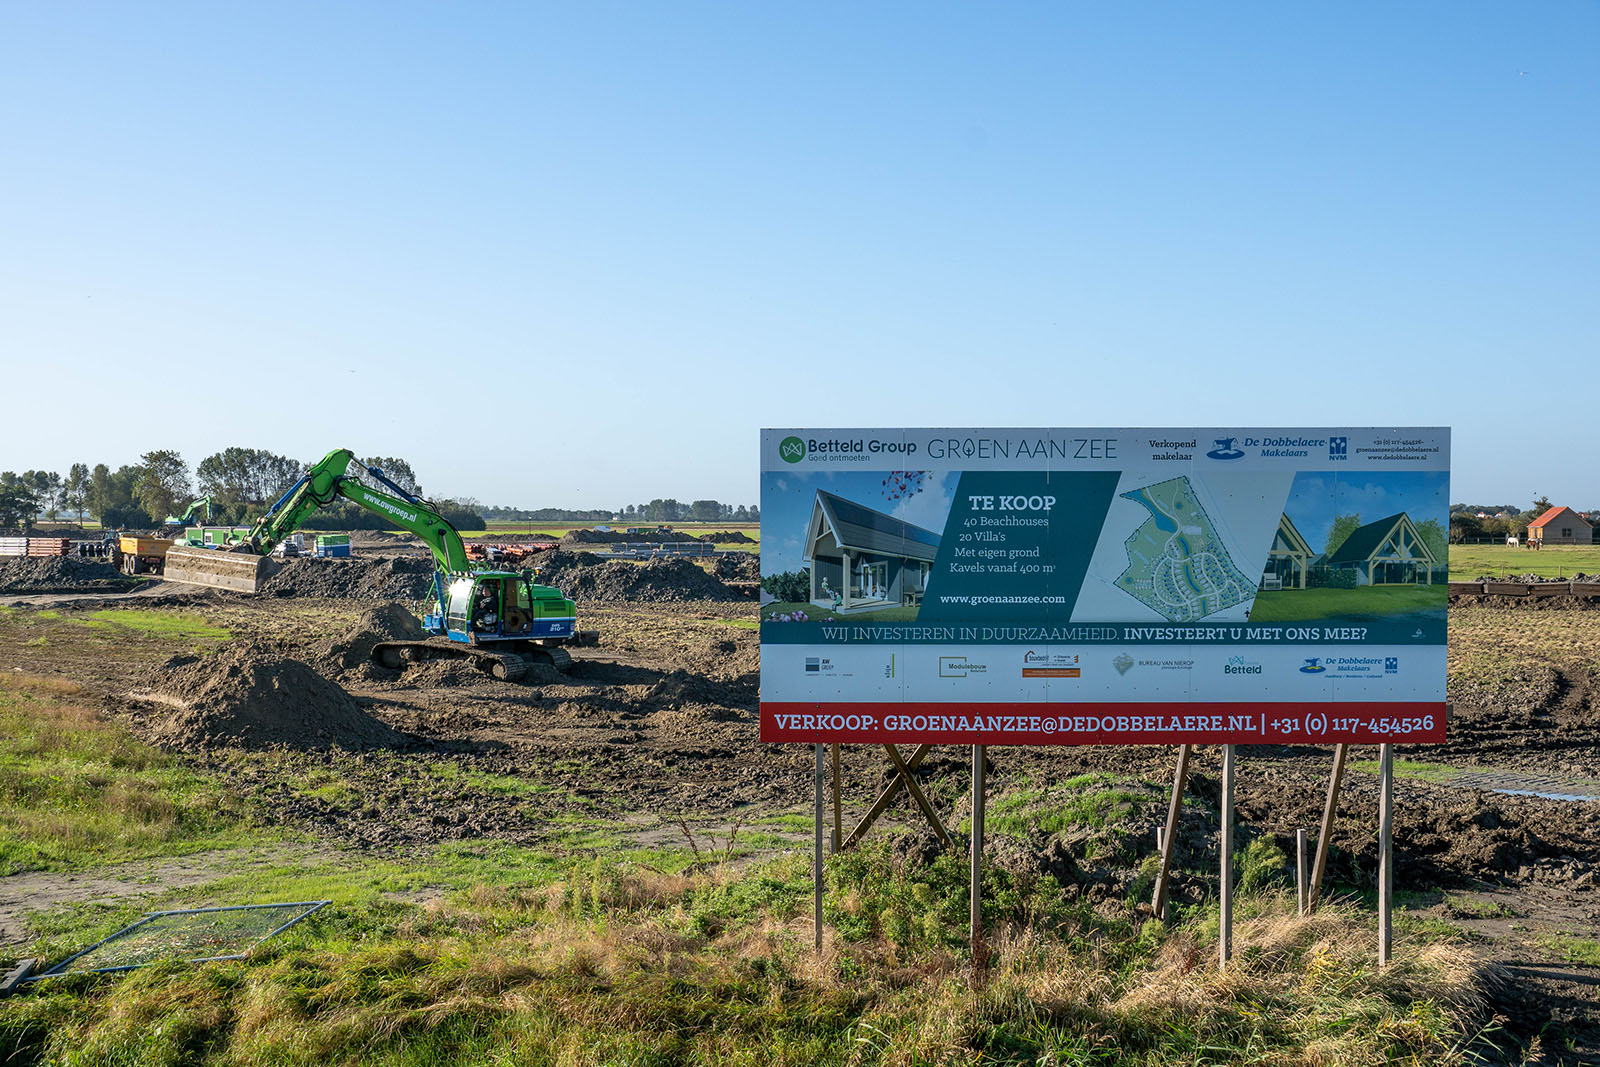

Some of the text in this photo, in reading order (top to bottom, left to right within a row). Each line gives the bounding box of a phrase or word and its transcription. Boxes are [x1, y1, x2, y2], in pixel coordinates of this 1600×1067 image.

[808, 439, 917, 455] Betteld Group
[1149, 440, 1196, 449] Verkopend
[1244, 438, 1325, 446] De Dobbelaere
[1015, 439, 1066, 459] AAN
[1073, 439, 1117, 459] ZEE
[1152, 452, 1192, 460] makelaar
[364, 492, 417, 522] www.awgroep.nl
[969, 496, 1056, 510] TE KOOP
[964, 515, 1049, 527] 40 Beachhouses
[960, 531, 1006, 542] 20 Villa's
[954, 546, 1040, 559] Met eigen grond
[950, 562, 985, 572] Kavels
[988, 562, 1017, 572] vanaf
[1020, 565, 1040, 574] 400
[940, 596, 1065, 606] www.groenaanzee.com
[822, 628, 849, 641] WIJ
[853, 628, 955, 640] INVESTEREN
[959, 628, 978, 640] IN
[1124, 628, 1227, 640] INVESTEERT
[1230, 628, 1243, 640] U
[1246, 628, 1283, 640] MET
[1286, 628, 1321, 640] ONS
[1324, 628, 1368, 640] MEE?
[1224, 664, 1262, 674] Betteld
[774, 714, 879, 730] VERKOOP:
[884, 715, 1256, 734] GROENAANZEE@DEDOBBELAERE.NL
[1270, 717, 1300, 733] +31
[1305, 712, 1328, 735] (0)
[1332, 714, 1434, 734] 117-454526
